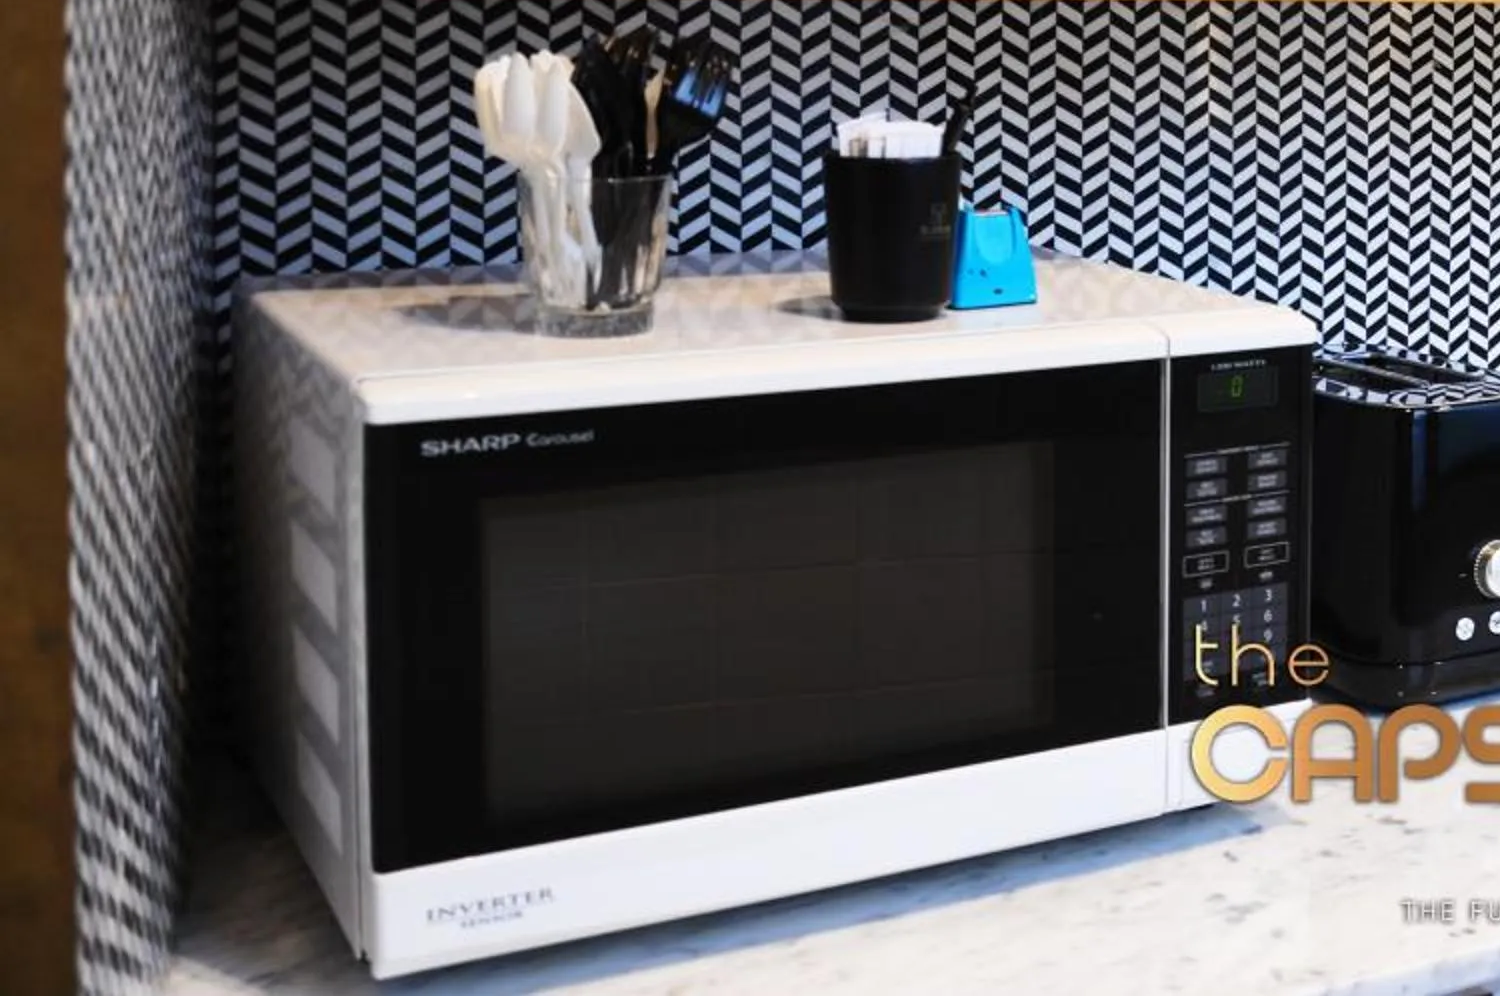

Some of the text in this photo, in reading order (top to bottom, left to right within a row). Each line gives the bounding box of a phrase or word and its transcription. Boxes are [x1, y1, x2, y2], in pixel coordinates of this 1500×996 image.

[420, 433, 521, 458] SHARP
[1201, 588, 1273, 613] 1 2 3
[1263, 609, 1273, 623] 6
[426, 888, 553, 921] INVERTER
